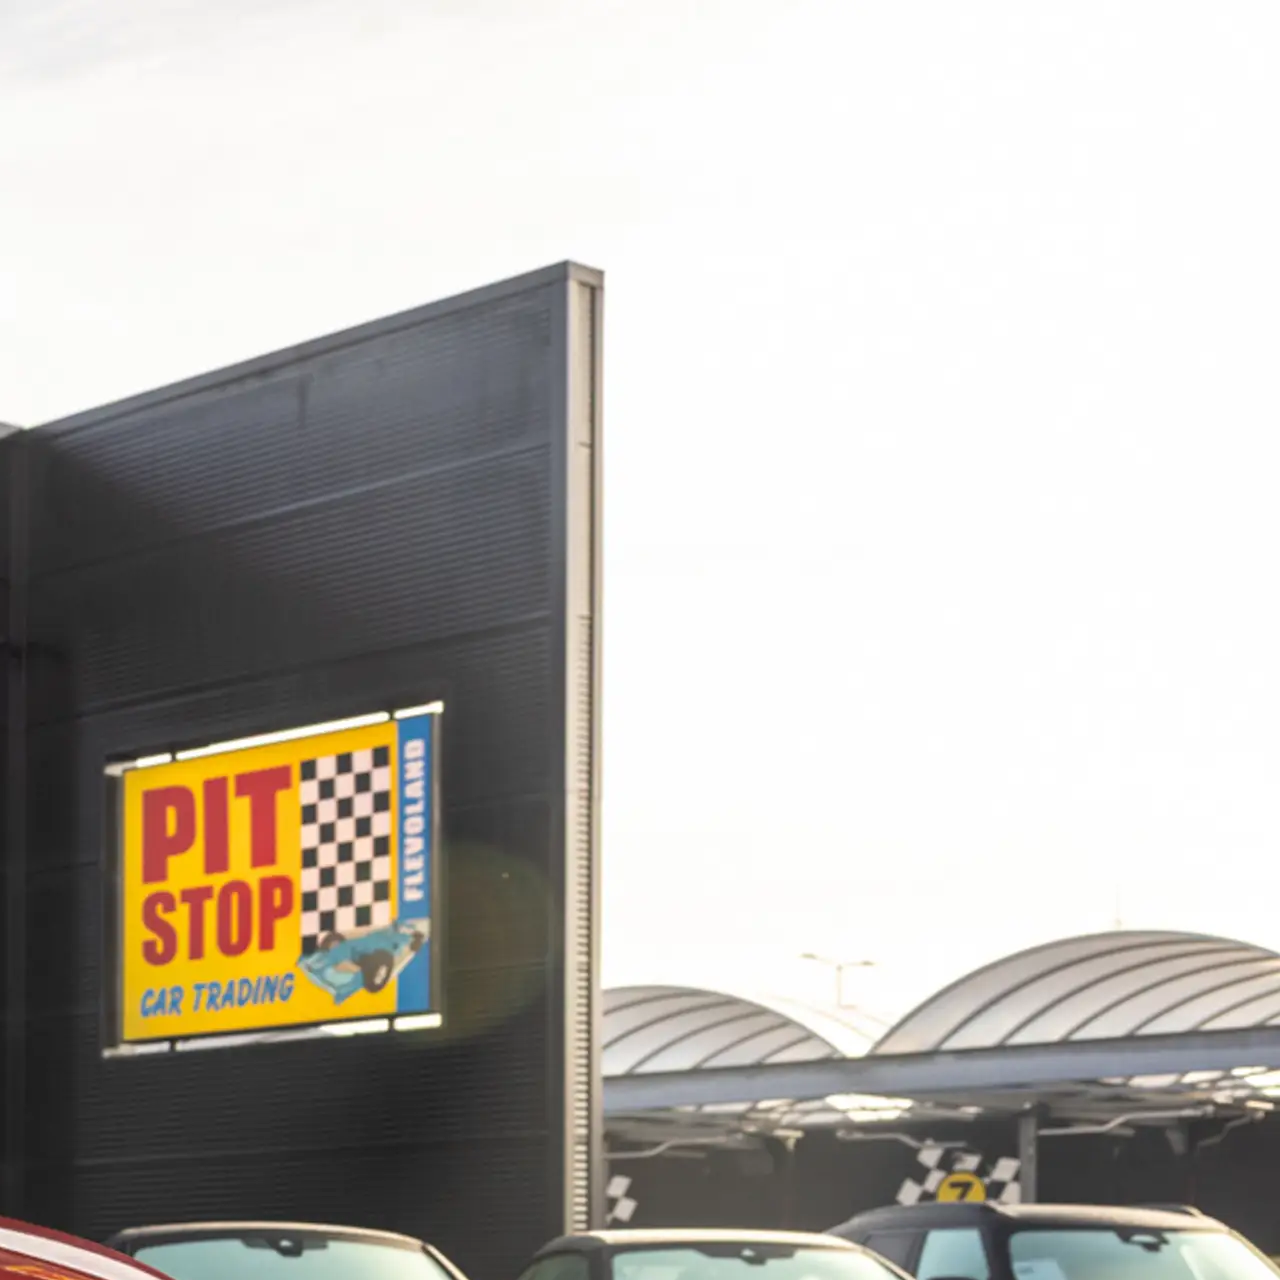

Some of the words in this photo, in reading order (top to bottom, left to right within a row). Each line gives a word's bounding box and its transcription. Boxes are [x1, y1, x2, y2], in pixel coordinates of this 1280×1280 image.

[142, 764, 293, 884] PIT
[403, 737, 426, 902] FLEVOLAND
[142, 874, 295, 966] STOP
[140, 984, 185, 1018] CAR
[192, 972, 295, 1013] TRADING
